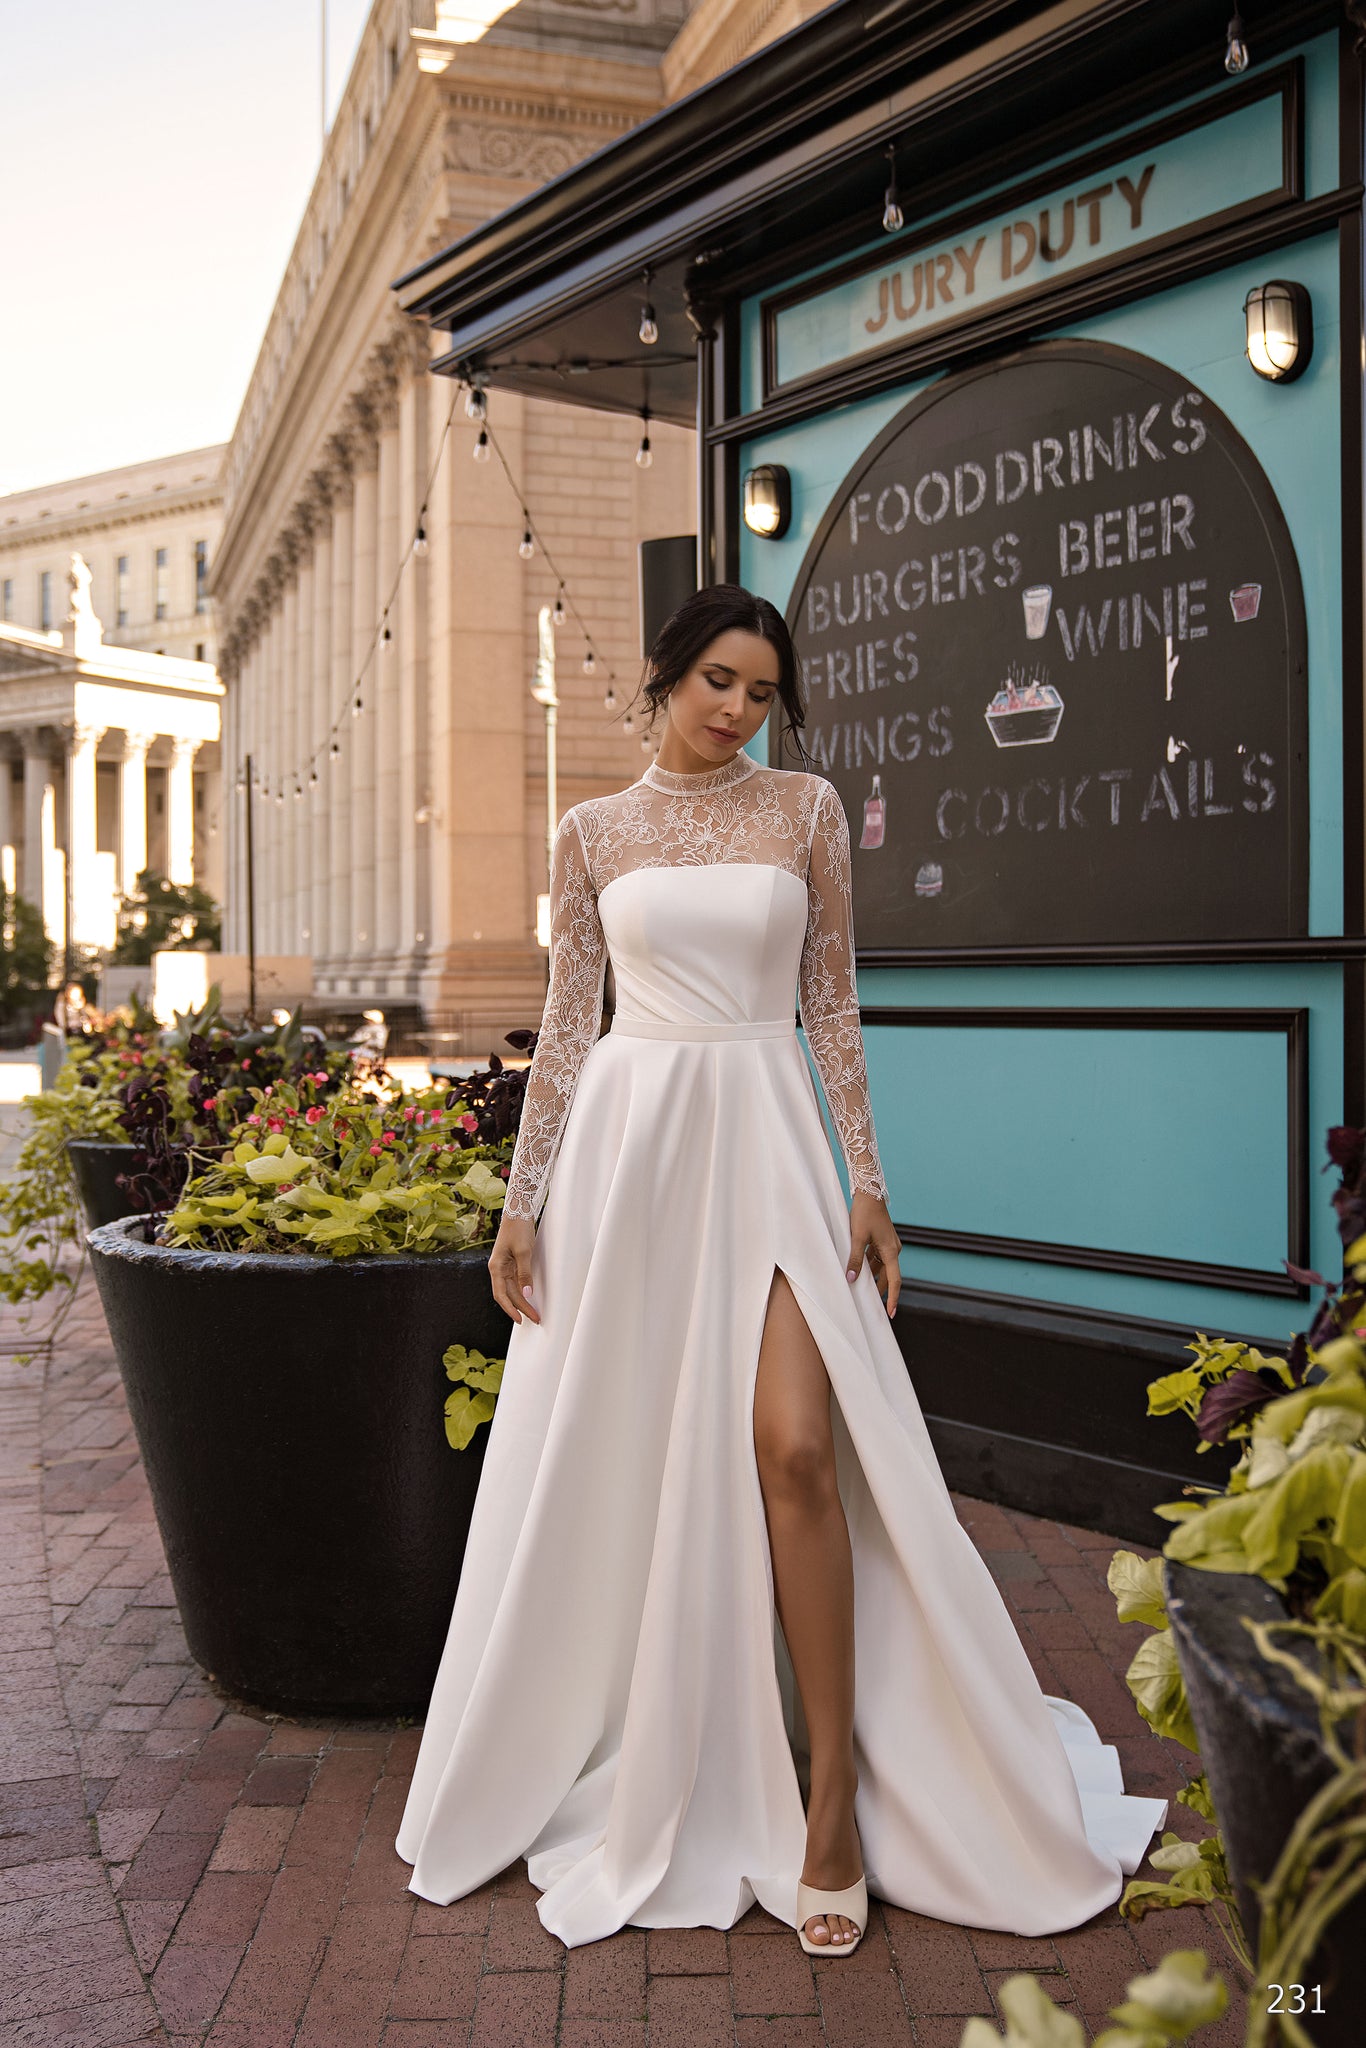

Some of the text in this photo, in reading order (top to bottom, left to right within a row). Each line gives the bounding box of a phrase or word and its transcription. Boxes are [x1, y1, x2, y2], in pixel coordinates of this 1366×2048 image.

[865, 164, 1156, 333] JURY DUTY
[995, 393, 1207, 505] DRINKS
[849, 462, 987, 545] FOOD
[1059, 494, 1196, 577] BEER
[807, 532, 1022, 634] BURGERS
[1056, 579, 1208, 661] WINE
[802, 631, 919, 704] FRIES
[800, 705, 953, 771] WINGS
[936, 752, 1277, 839] COCKTAILS
